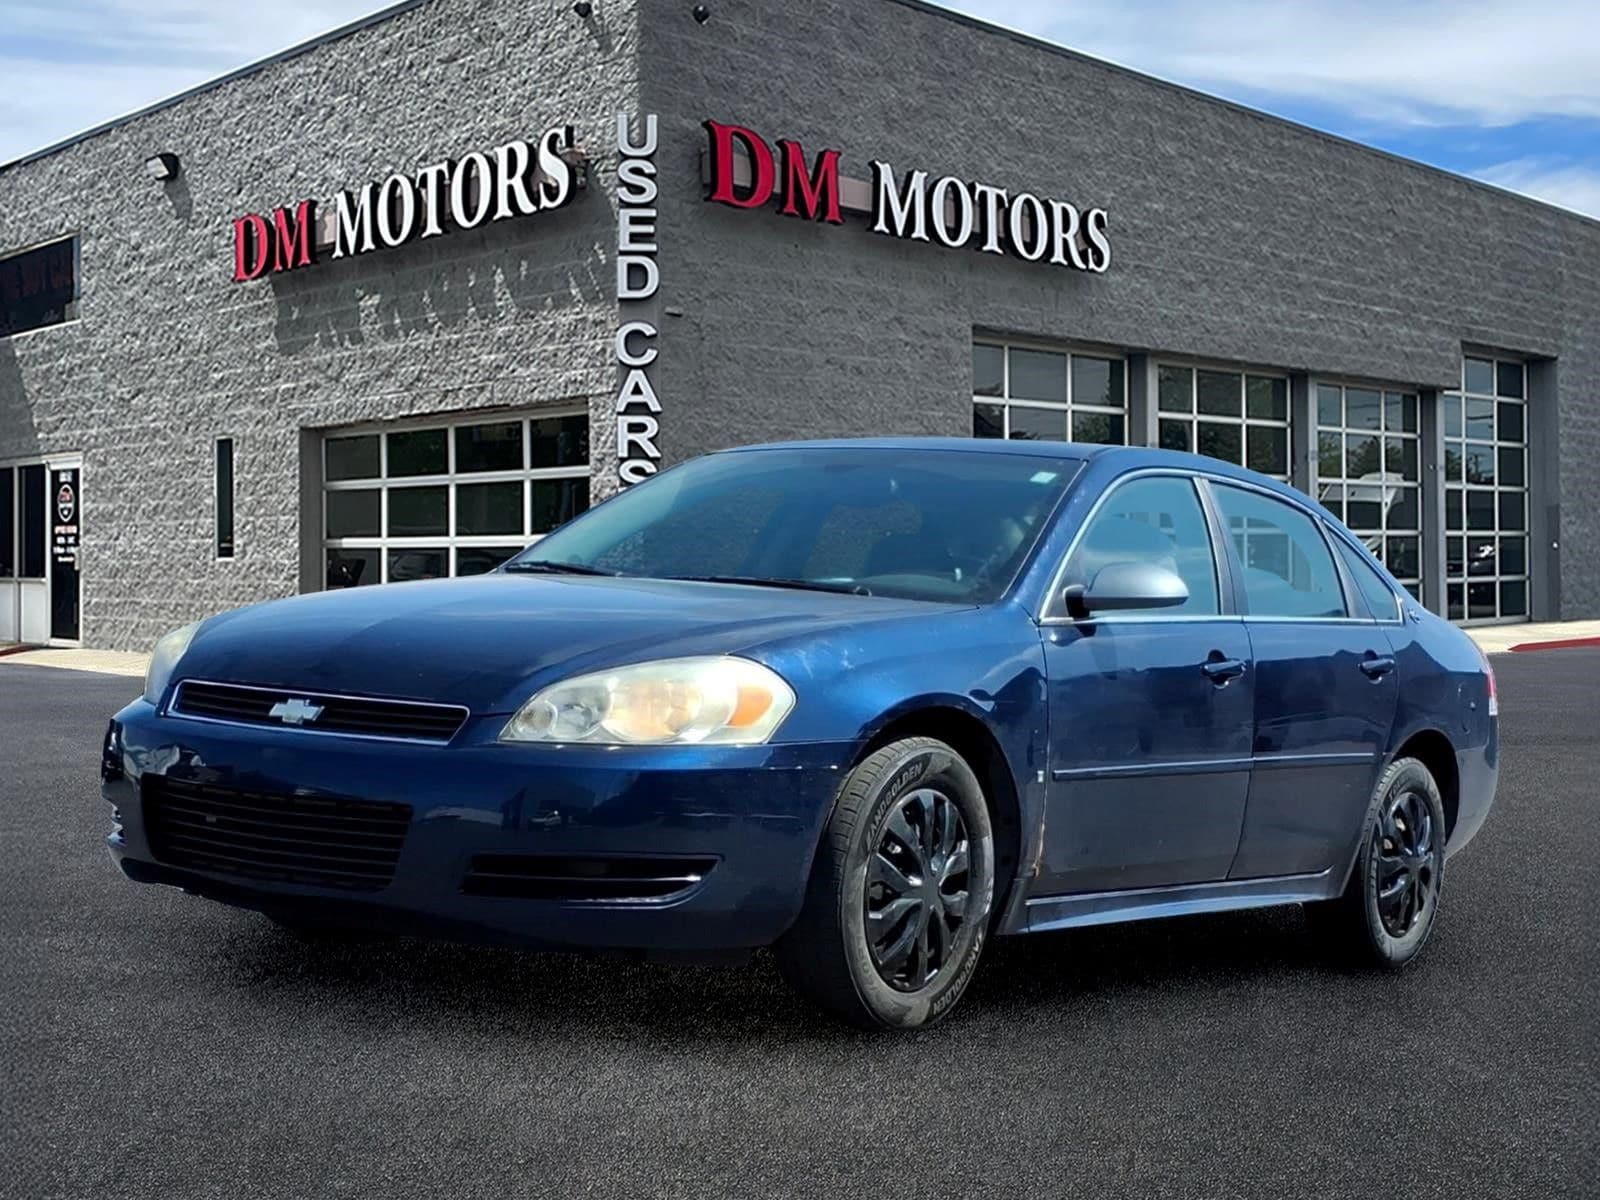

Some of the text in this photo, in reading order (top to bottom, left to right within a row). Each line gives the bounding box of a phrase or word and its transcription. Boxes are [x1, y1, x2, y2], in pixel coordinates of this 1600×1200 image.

[232, 125, 575, 282] DM MOTORS
[617, 114, 659, 299] USED
[703, 119, 1112, 273] DM MOTORS
